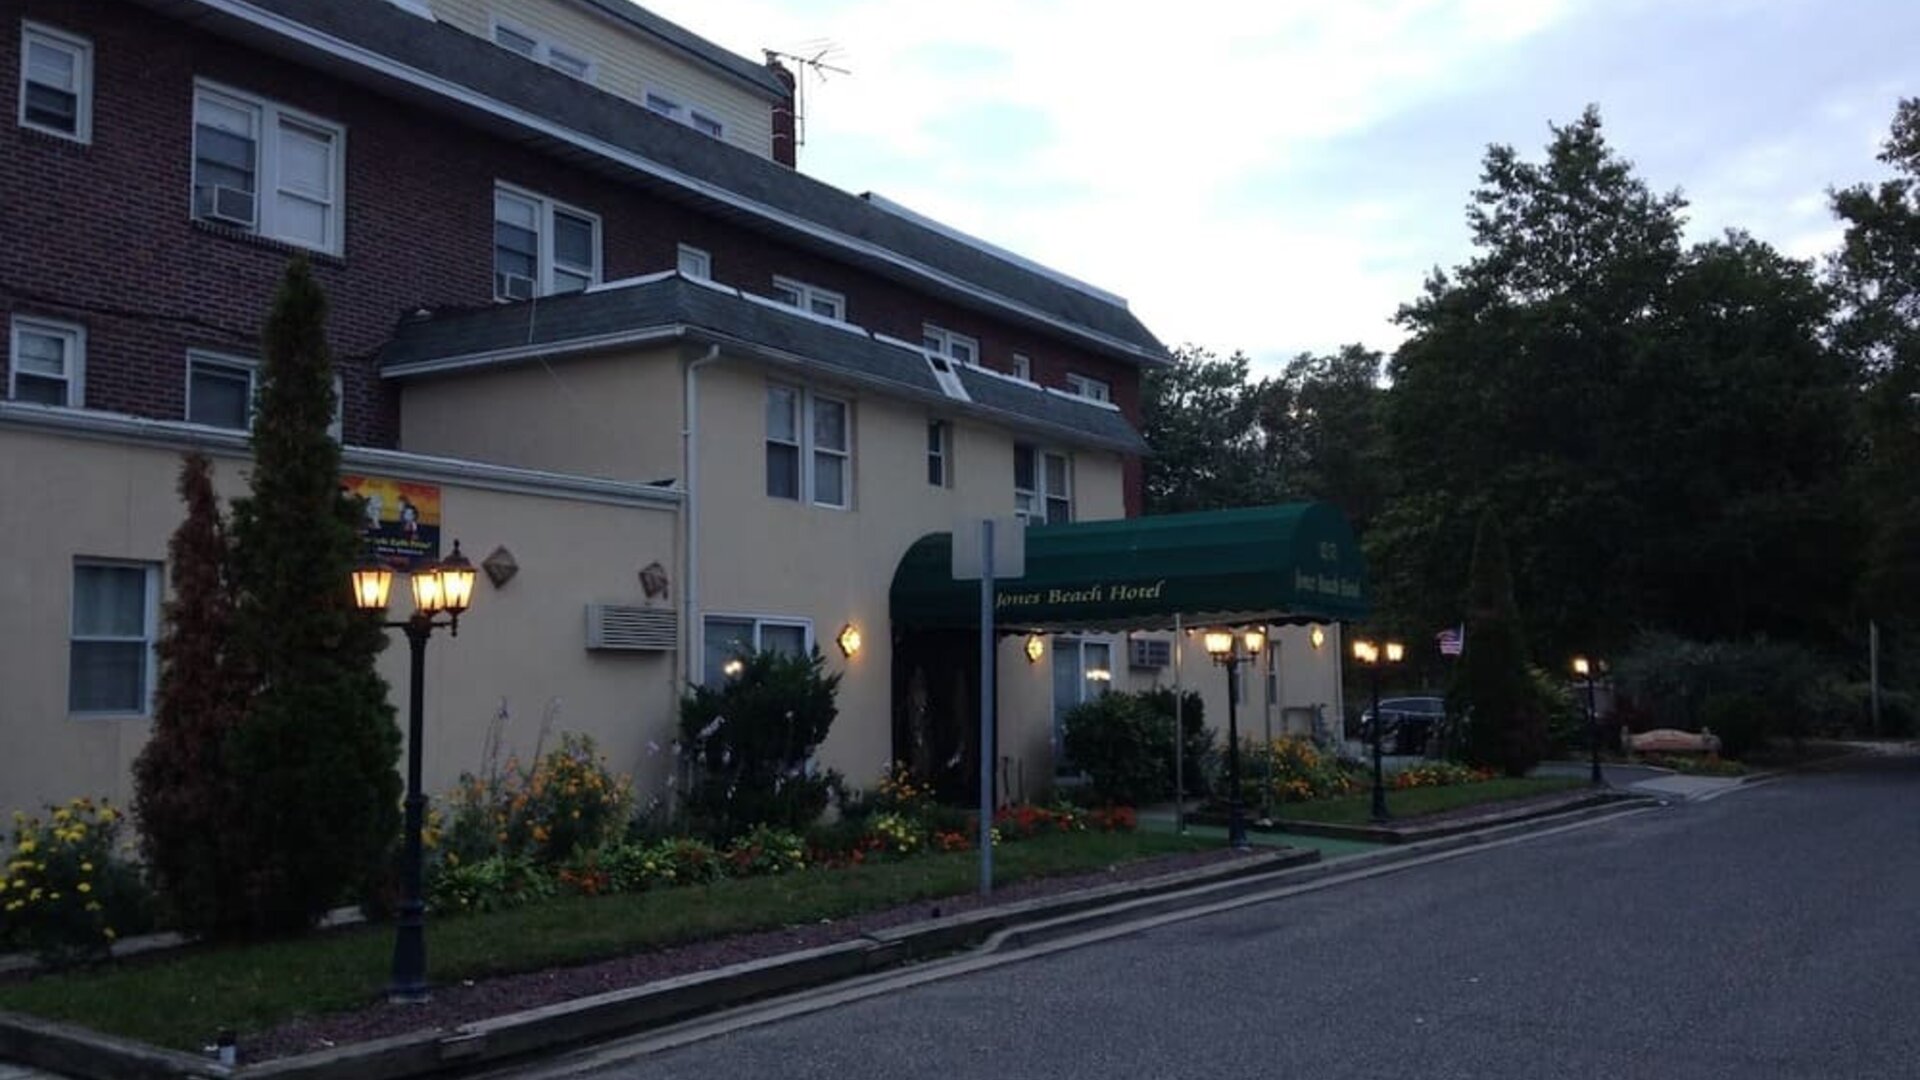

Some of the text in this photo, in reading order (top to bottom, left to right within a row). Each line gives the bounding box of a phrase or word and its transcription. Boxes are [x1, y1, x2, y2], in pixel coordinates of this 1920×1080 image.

[996, 579, 1166, 608] Jones Beach Hotel
